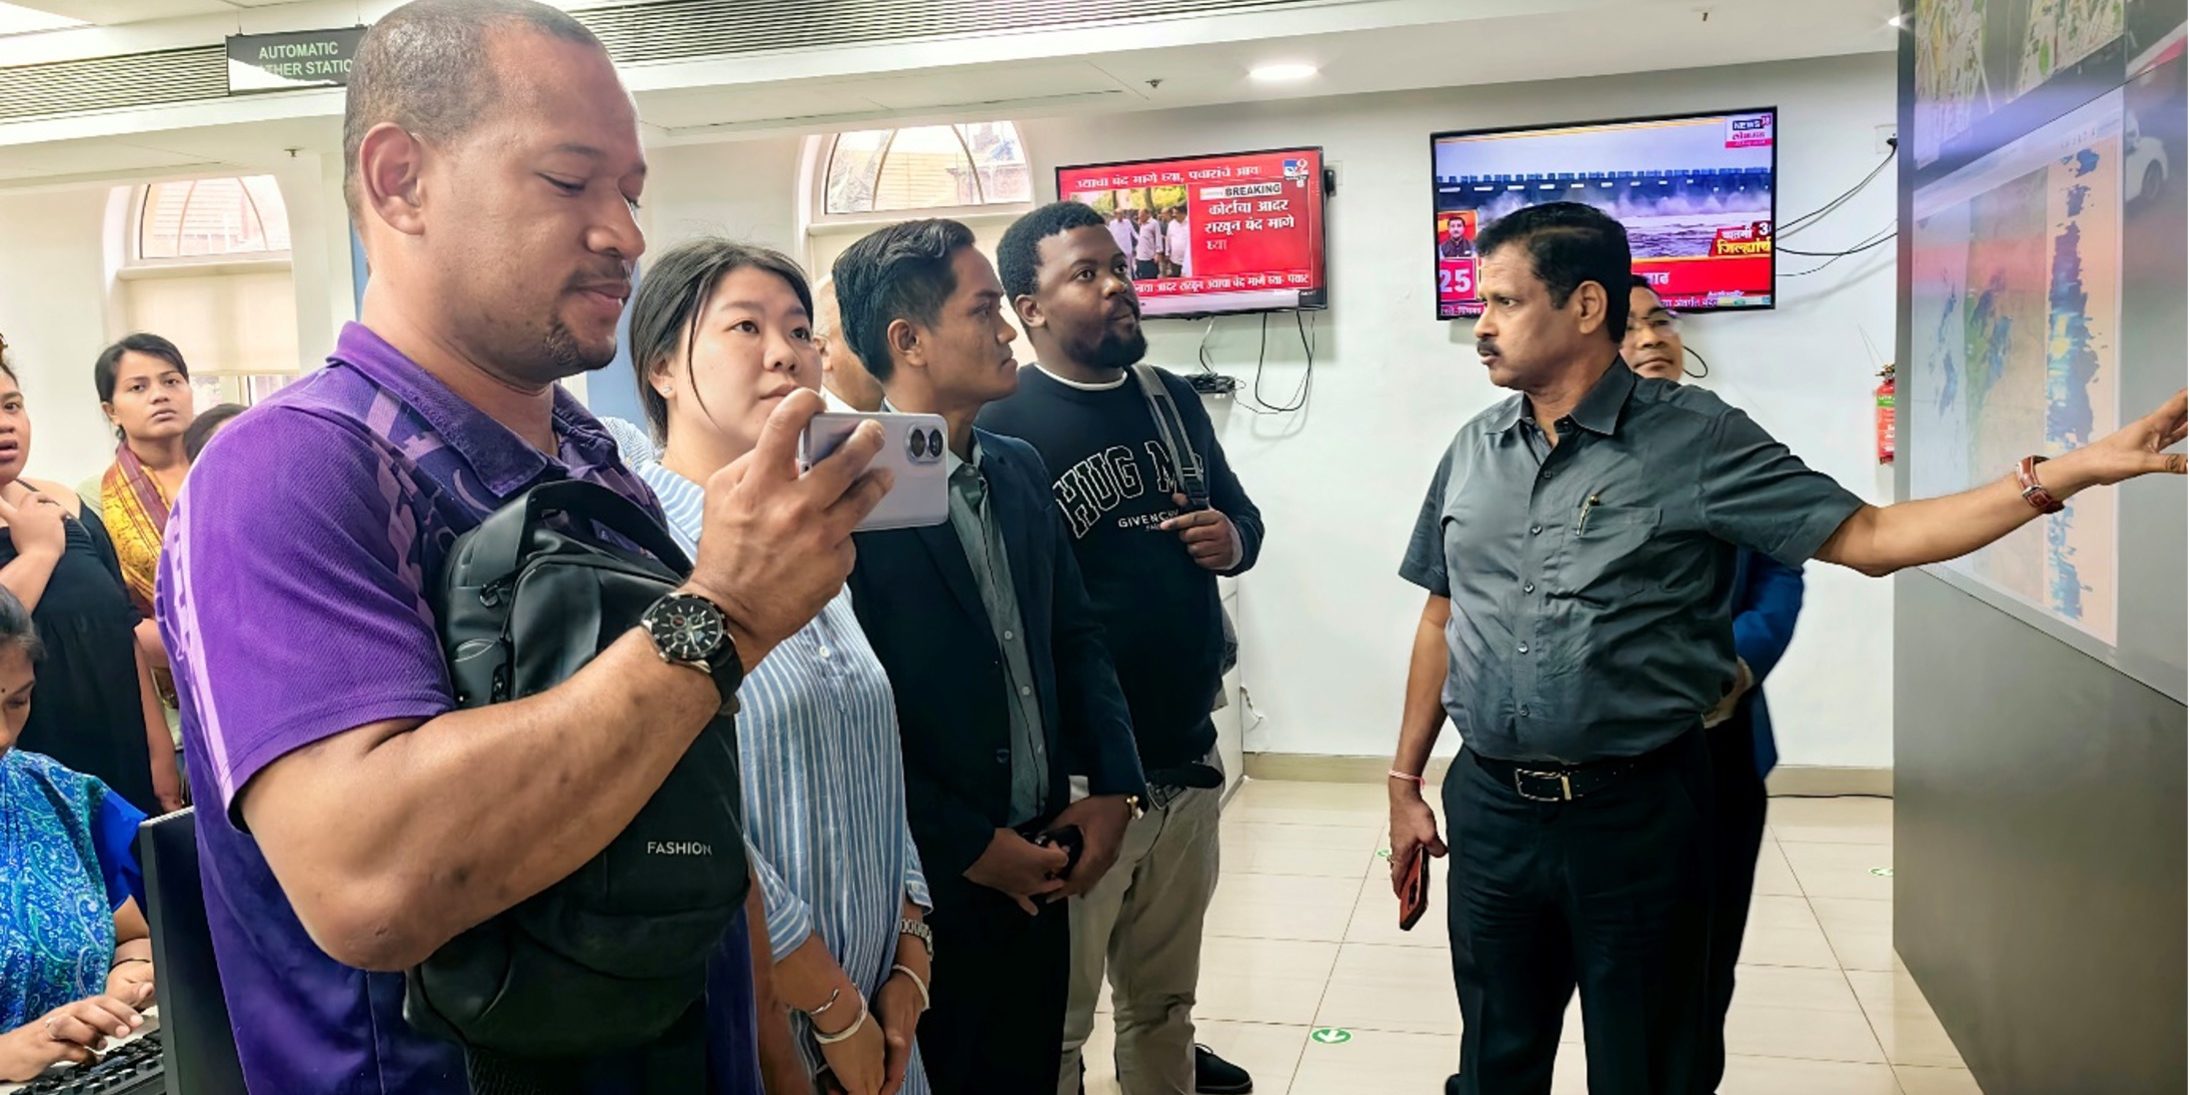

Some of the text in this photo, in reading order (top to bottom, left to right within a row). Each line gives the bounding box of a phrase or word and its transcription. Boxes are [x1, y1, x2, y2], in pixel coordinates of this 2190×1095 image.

[259, 42, 338, 59] AUTOMATIC
[264, 59, 352, 77] THER STATIO
[1225, 184, 1281, 197] BREAKING
[1257, 199, 1289, 212] आदर
[1204, 220, 1241, 235] राखून
[1267, 214, 1295, 229] मागे
[1439, 268, 1472, 293] 25
[1052, 444, 1144, 539] HUG
[647, 841, 712, 856] FASHION
